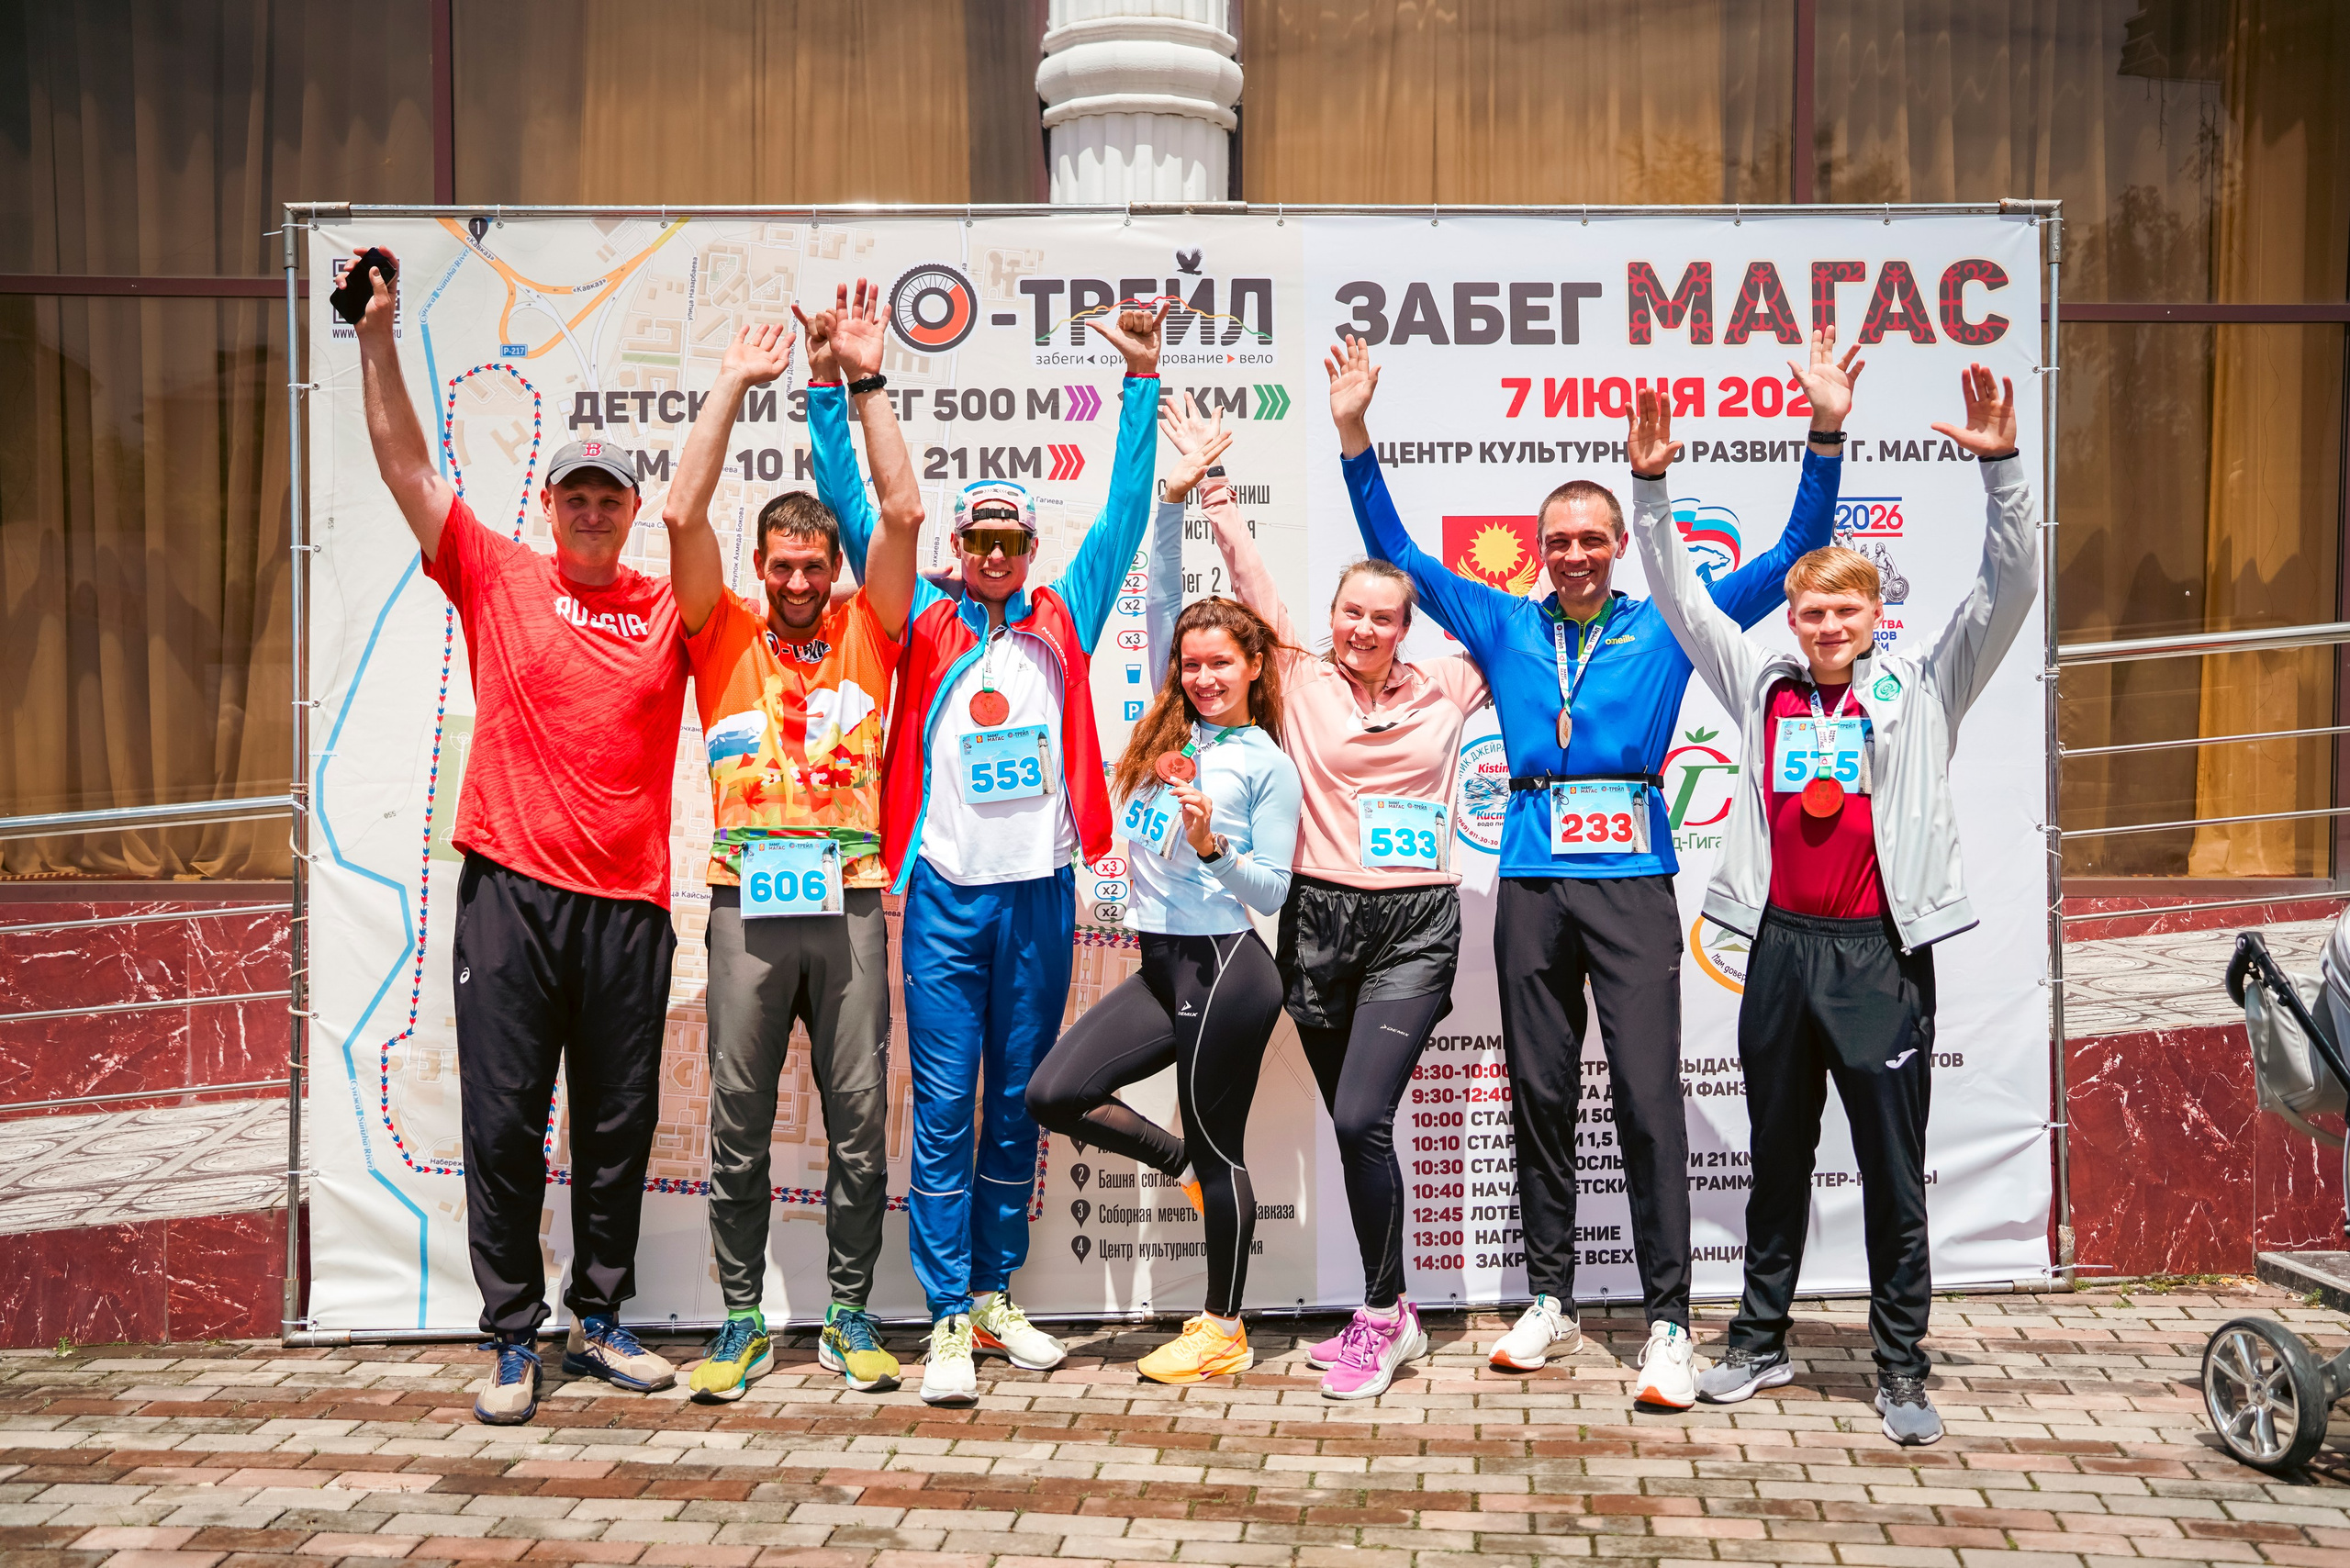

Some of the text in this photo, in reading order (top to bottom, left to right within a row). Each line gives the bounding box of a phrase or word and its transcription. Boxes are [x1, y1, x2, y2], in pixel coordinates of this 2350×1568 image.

[572, 277, 607, 294] «Кавказ»
[687, 256, 698, 321] улица Назарбаева
[1334, 259, 2011, 346] ЗАБЕГ МАГАС
[1035, 353, 1273, 367] забеги орирование вело
[569, 382, 777, 431] ДЕТСКЙ
[933, 388, 1015, 421] 500
[1026, 387, 1060, 420] М
[1501, 377, 1532, 418] 7
[1718, 376, 1852, 419] 202
[735, 448, 784, 481] 10
[923, 446, 968, 480] 21
[980, 446, 1042, 479] КМ
[1378, 440, 1975, 467] ЦЕНТР КУЛЬТУРНО РАЗВИТ Г. МАГАС
[1035, 496, 1064, 505] Гагиева
[633, 521, 655, 529] улица
[1836, 504, 1904, 530] 2026
[731, 507, 744, 591] ереулок Ахмеда Бокова
[932, 537, 940, 567] ахкиева
[1125, 599, 1140, 610] x2
[1125, 633, 1141, 644] x3
[971, 756, 1042, 793] 553
[1125, 799, 1169, 842] 515
[1561, 812, 1633, 843] 233
[1371, 828, 1438, 859] 533
[1469, 831, 1499, 846] 811-30-30
[1102, 860, 1117, 871] x3
[681, 890, 711, 900] Кайсын
[750, 870, 827, 902] 606
[1102, 884, 1118, 895] x2
[1102, 905, 1118, 916] x2
[1724, 965, 1747, 986] довер
[1425, 1035, 1505, 1052] РОГРАМ
[1411, 1086, 1513, 1103] 9:30-12:40
[1411, 1111, 1464, 1128] 10:00
[358, 1116, 369, 1146] Sunzha
[1412, 1131, 1613, 1152] 10:10 СТАР 1,5
[430, 1159, 464, 1167] Набереж
[1412, 1159, 1464, 1175] 10:30
[1471, 1158, 1517, 1174] СТАР
[1707, 1152, 1728, 1167] 21
[1078, 1167, 1084, 1182] 2
[1098, 1169, 1136, 1189] Башня
[1412, 1182, 1464, 1199] 10:40
[1472, 1182, 1520, 1198] НАЧА
[1077, 1203, 1083, 1218] 3
[1099, 1204, 1152, 1225] Соборная
[1158, 1206, 1198, 1223] мечеть
[1413, 1205, 1521, 1223] 12:45 ЛОТЕ
[1413, 1230, 1464, 1247] 13:00
[1077, 1238, 1207, 1261] 4 Центр культурного
[1413, 1254, 1465, 1271] 14:00
[1584, 1249, 1635, 1265] ВСЕХ
